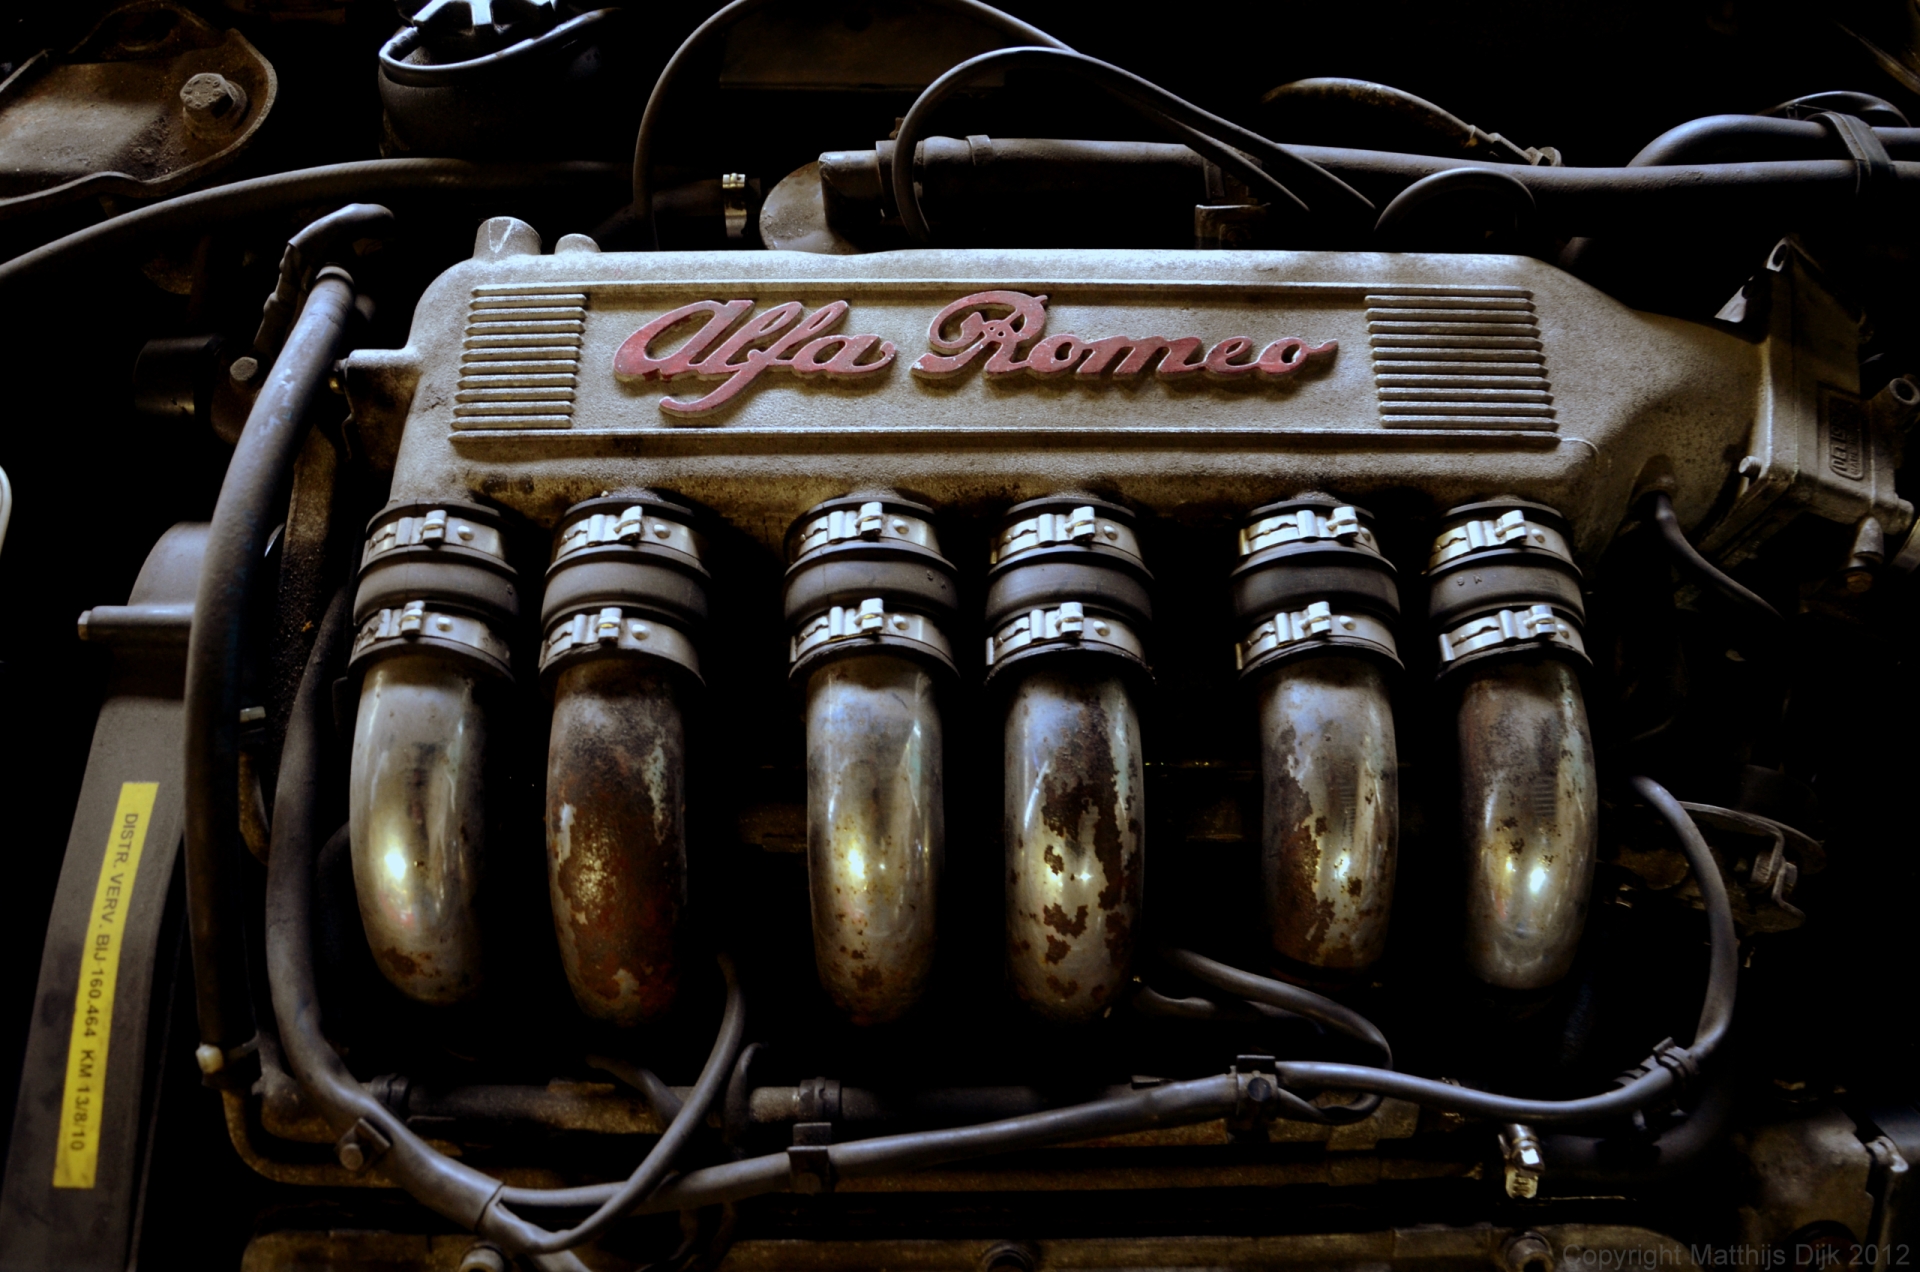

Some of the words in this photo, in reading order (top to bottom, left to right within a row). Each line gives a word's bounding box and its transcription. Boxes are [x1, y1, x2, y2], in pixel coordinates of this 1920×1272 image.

[612, 298, 898, 419] Alfa
[909, 289, 1339, 381] Romeo
[113, 813, 139, 869] DISTR.
[93, 934, 111, 962] BIJ
[83, 969, 105, 1038] 160.464
[78, 1049, 95, 1079] KM
[70, 1086, 91, 1152] 13/8/10
